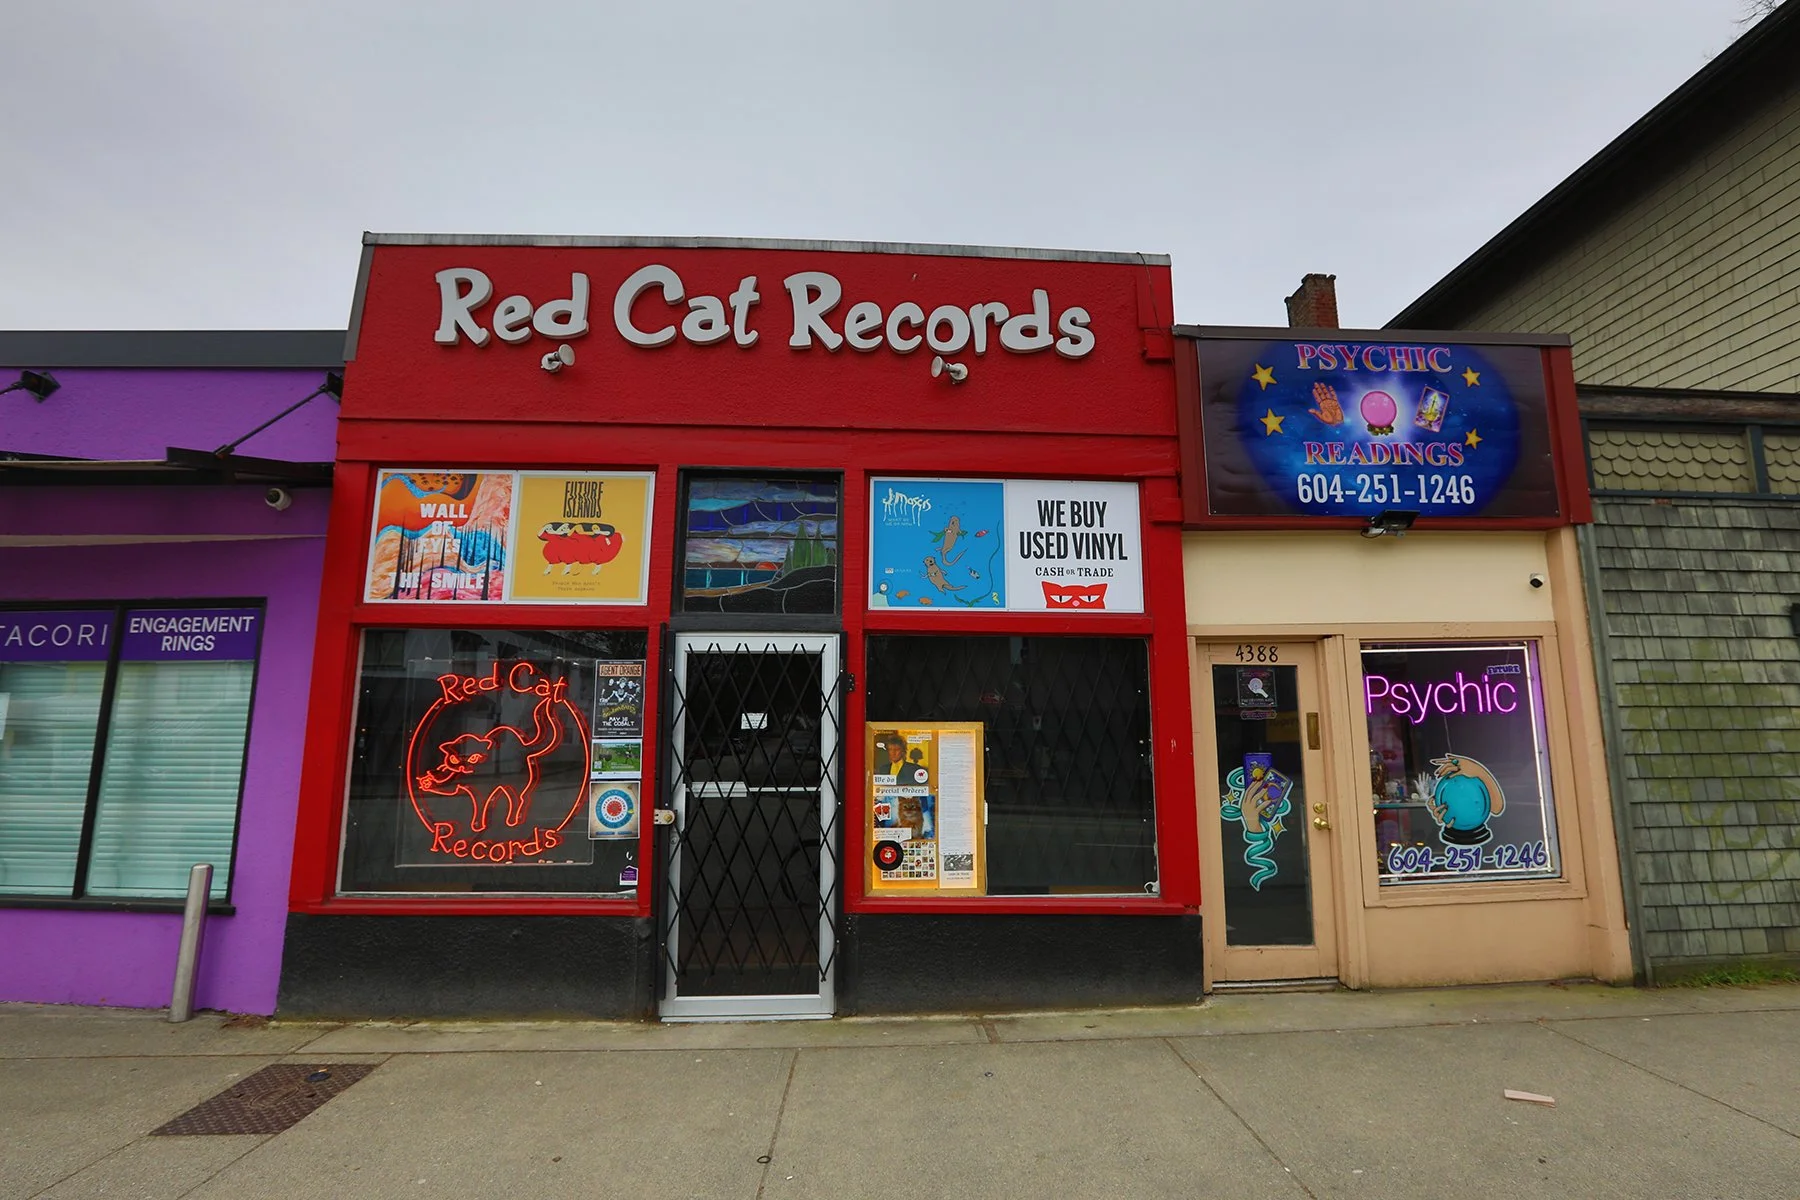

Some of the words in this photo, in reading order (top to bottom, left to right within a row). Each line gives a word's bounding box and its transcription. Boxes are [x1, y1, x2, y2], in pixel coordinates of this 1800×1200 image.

[433, 267, 590, 347] Red
[613, 263, 761, 348] Cat
[783, 271, 1097, 359] Records
[1294, 343, 1453, 373] PSYCHIC
[1303, 441, 1465, 467] READINGS
[565, 481, 604, 500] FUTURE
[1297, 473, 1475, 505] 604-251-1246
[419, 503, 469, 519] WALL
[563, 496, 602, 518] ISLANDS
[1037, 499, 1067, 527] WE
[1070, 500, 1107, 528] BUY
[432, 520, 454, 536] OF
[418, 538, 461, 553] EYES
[1019, 531, 1069, 560] USED
[1072, 532, 1128, 561] VINYL
[432, 572, 489, 589] SMILE
[1035, 566, 1065, 577] CASH
[1077, 567, 1114, 578] TRADE
[0, 624, 109, 647] ACORI
[129, 616, 254, 633] ENGAGEMENT
[161, 635, 216, 652] RINGS
[1235, 645, 1279, 663] 4388
[1487, 665, 1520, 675] FUTURE
[437, 662, 500, 704] Red
[509, 662, 568, 703] Cat
[1365, 671, 1517, 725] Psychic
[431, 822, 558, 862] Records
[1388, 842, 1548, 874] 604-251-1246
